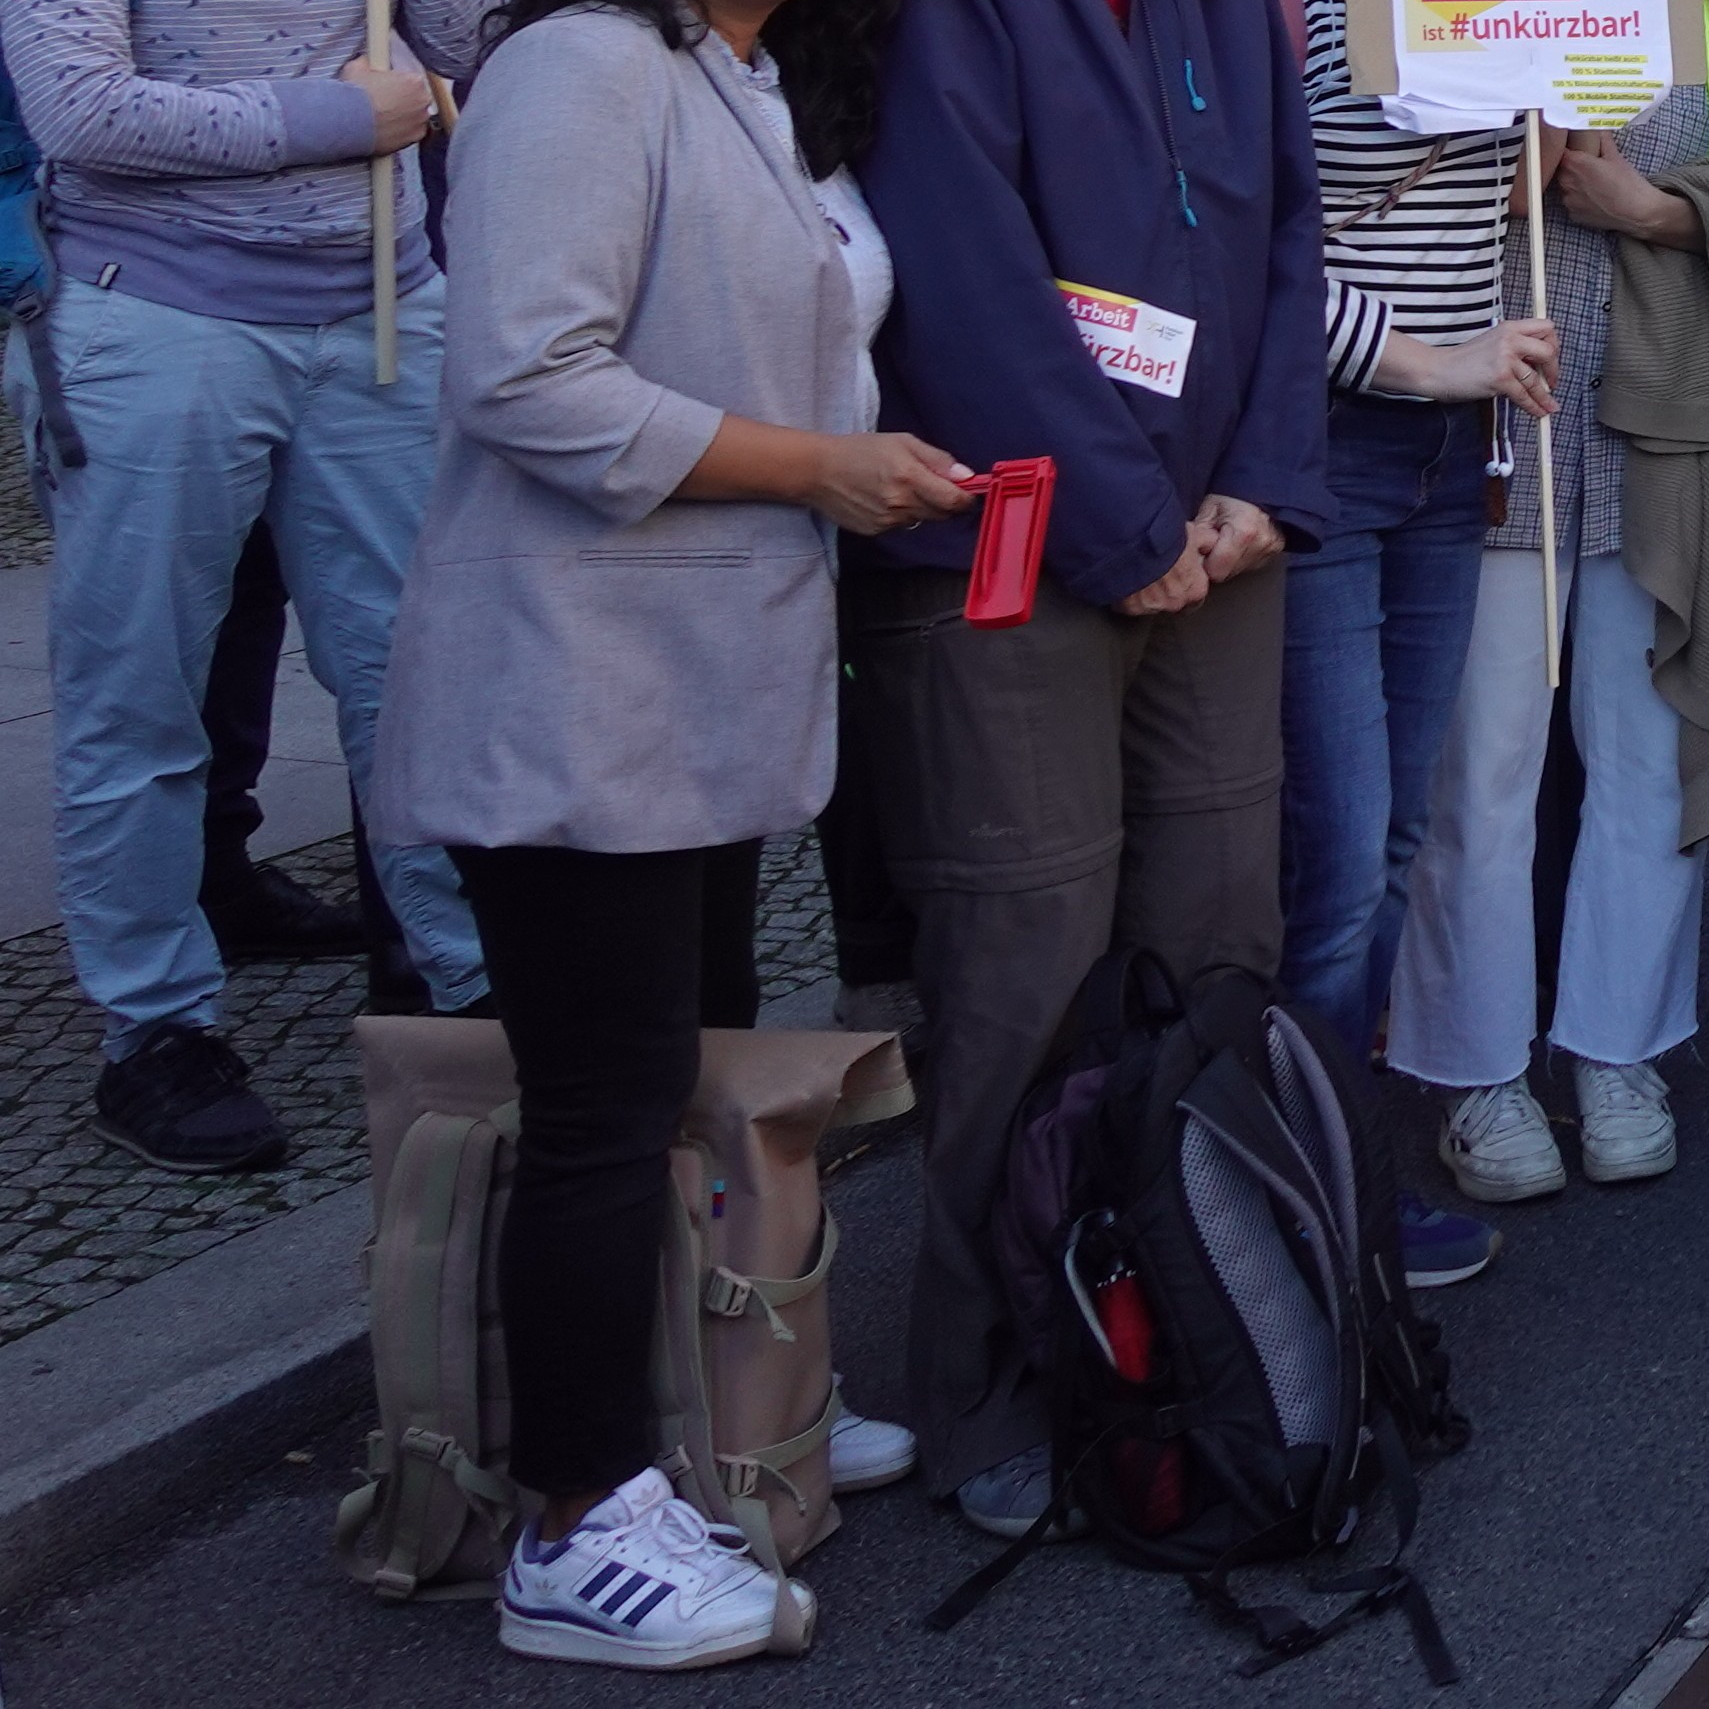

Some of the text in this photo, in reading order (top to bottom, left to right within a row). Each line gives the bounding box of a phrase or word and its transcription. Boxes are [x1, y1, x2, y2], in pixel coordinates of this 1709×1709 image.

[1423, 9, 1640, 41] ist #unkürzbar!
[1066, 296, 1131, 328] Arbeit
